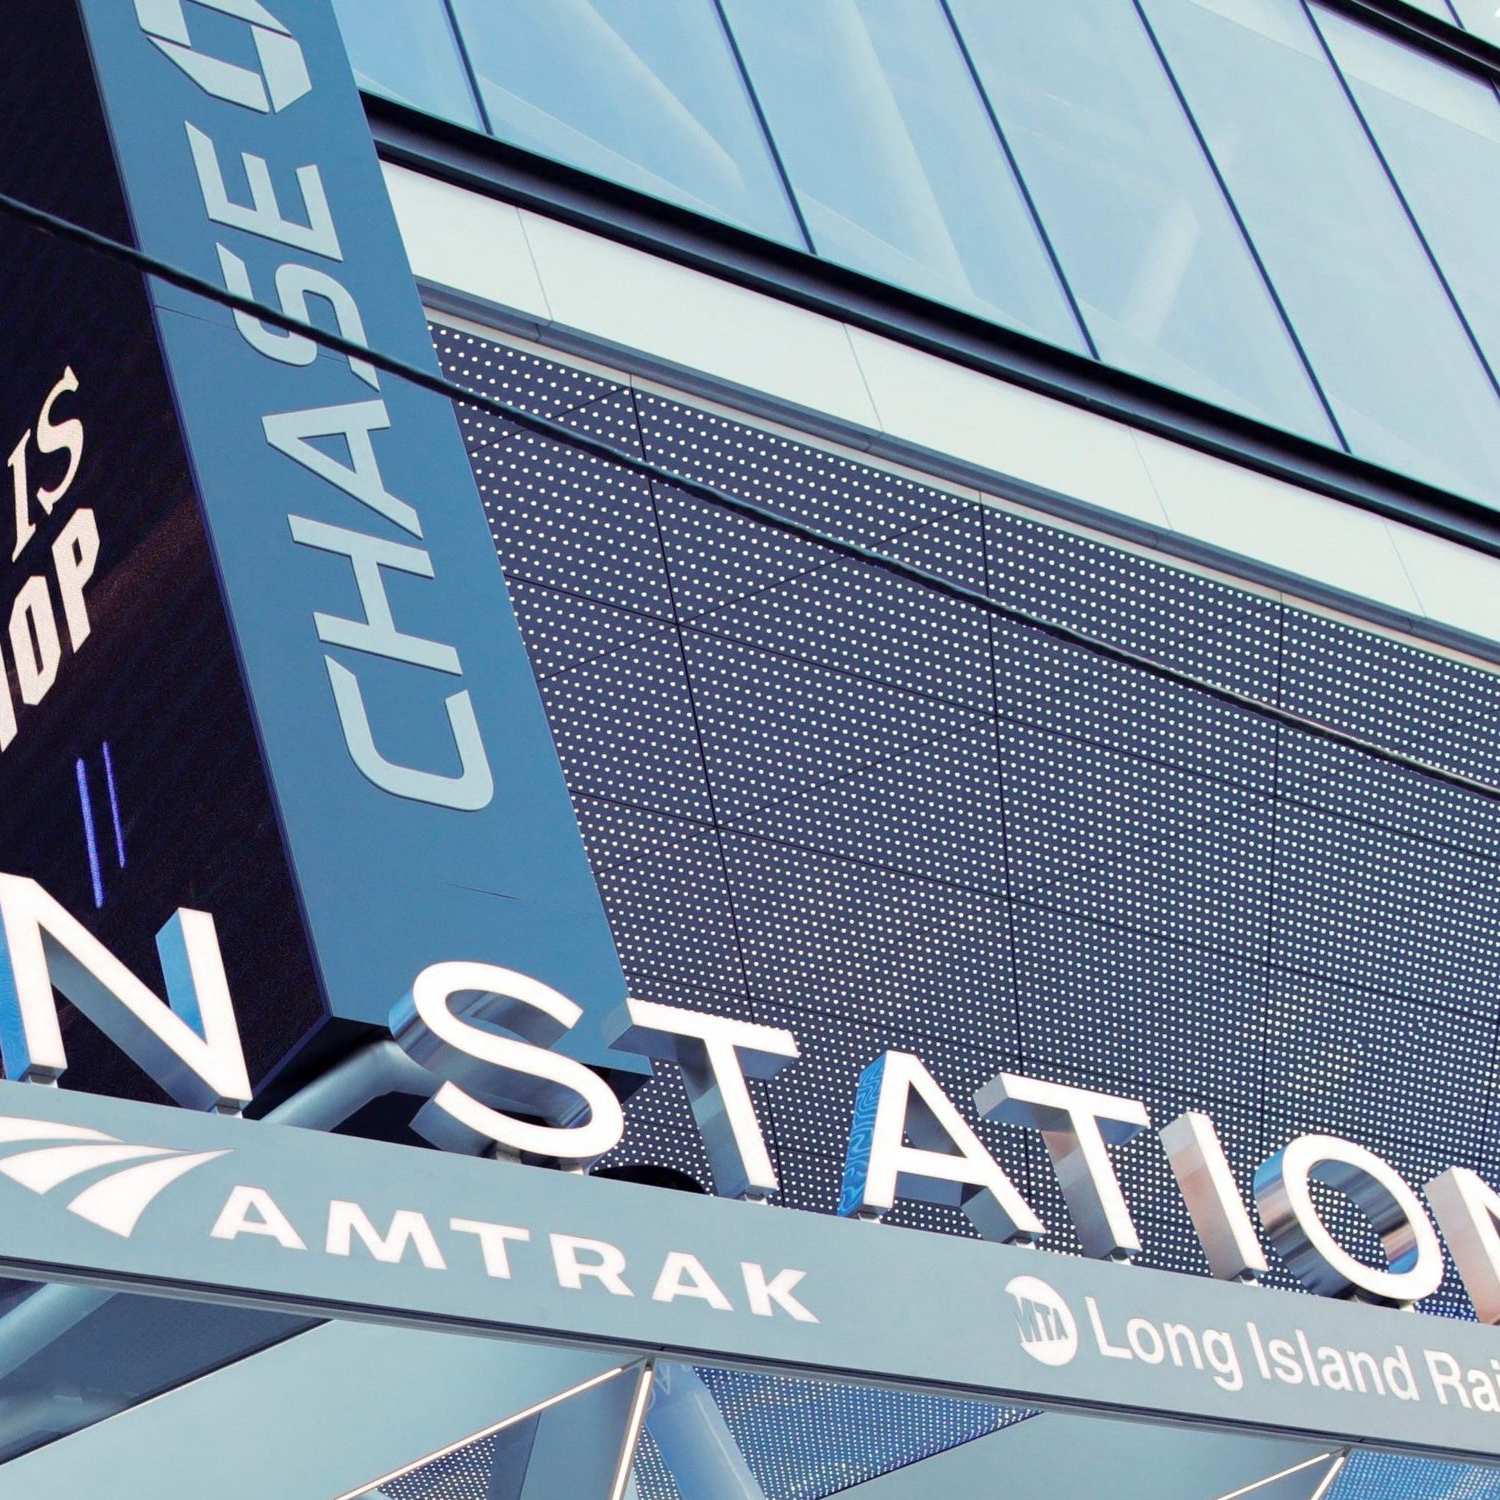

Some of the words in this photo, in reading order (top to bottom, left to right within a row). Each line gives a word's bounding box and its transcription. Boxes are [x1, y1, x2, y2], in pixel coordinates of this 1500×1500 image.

[6, 364, 85, 562] IS
[184, 119, 494, 812] CHASE
[210, 1185, 821, 1324] AMTRAK
[1084, 1296, 1244, 1391] Long
[1253, 1320, 1421, 1403] Island
[1423, 1348, 1500, 1413] Rai
